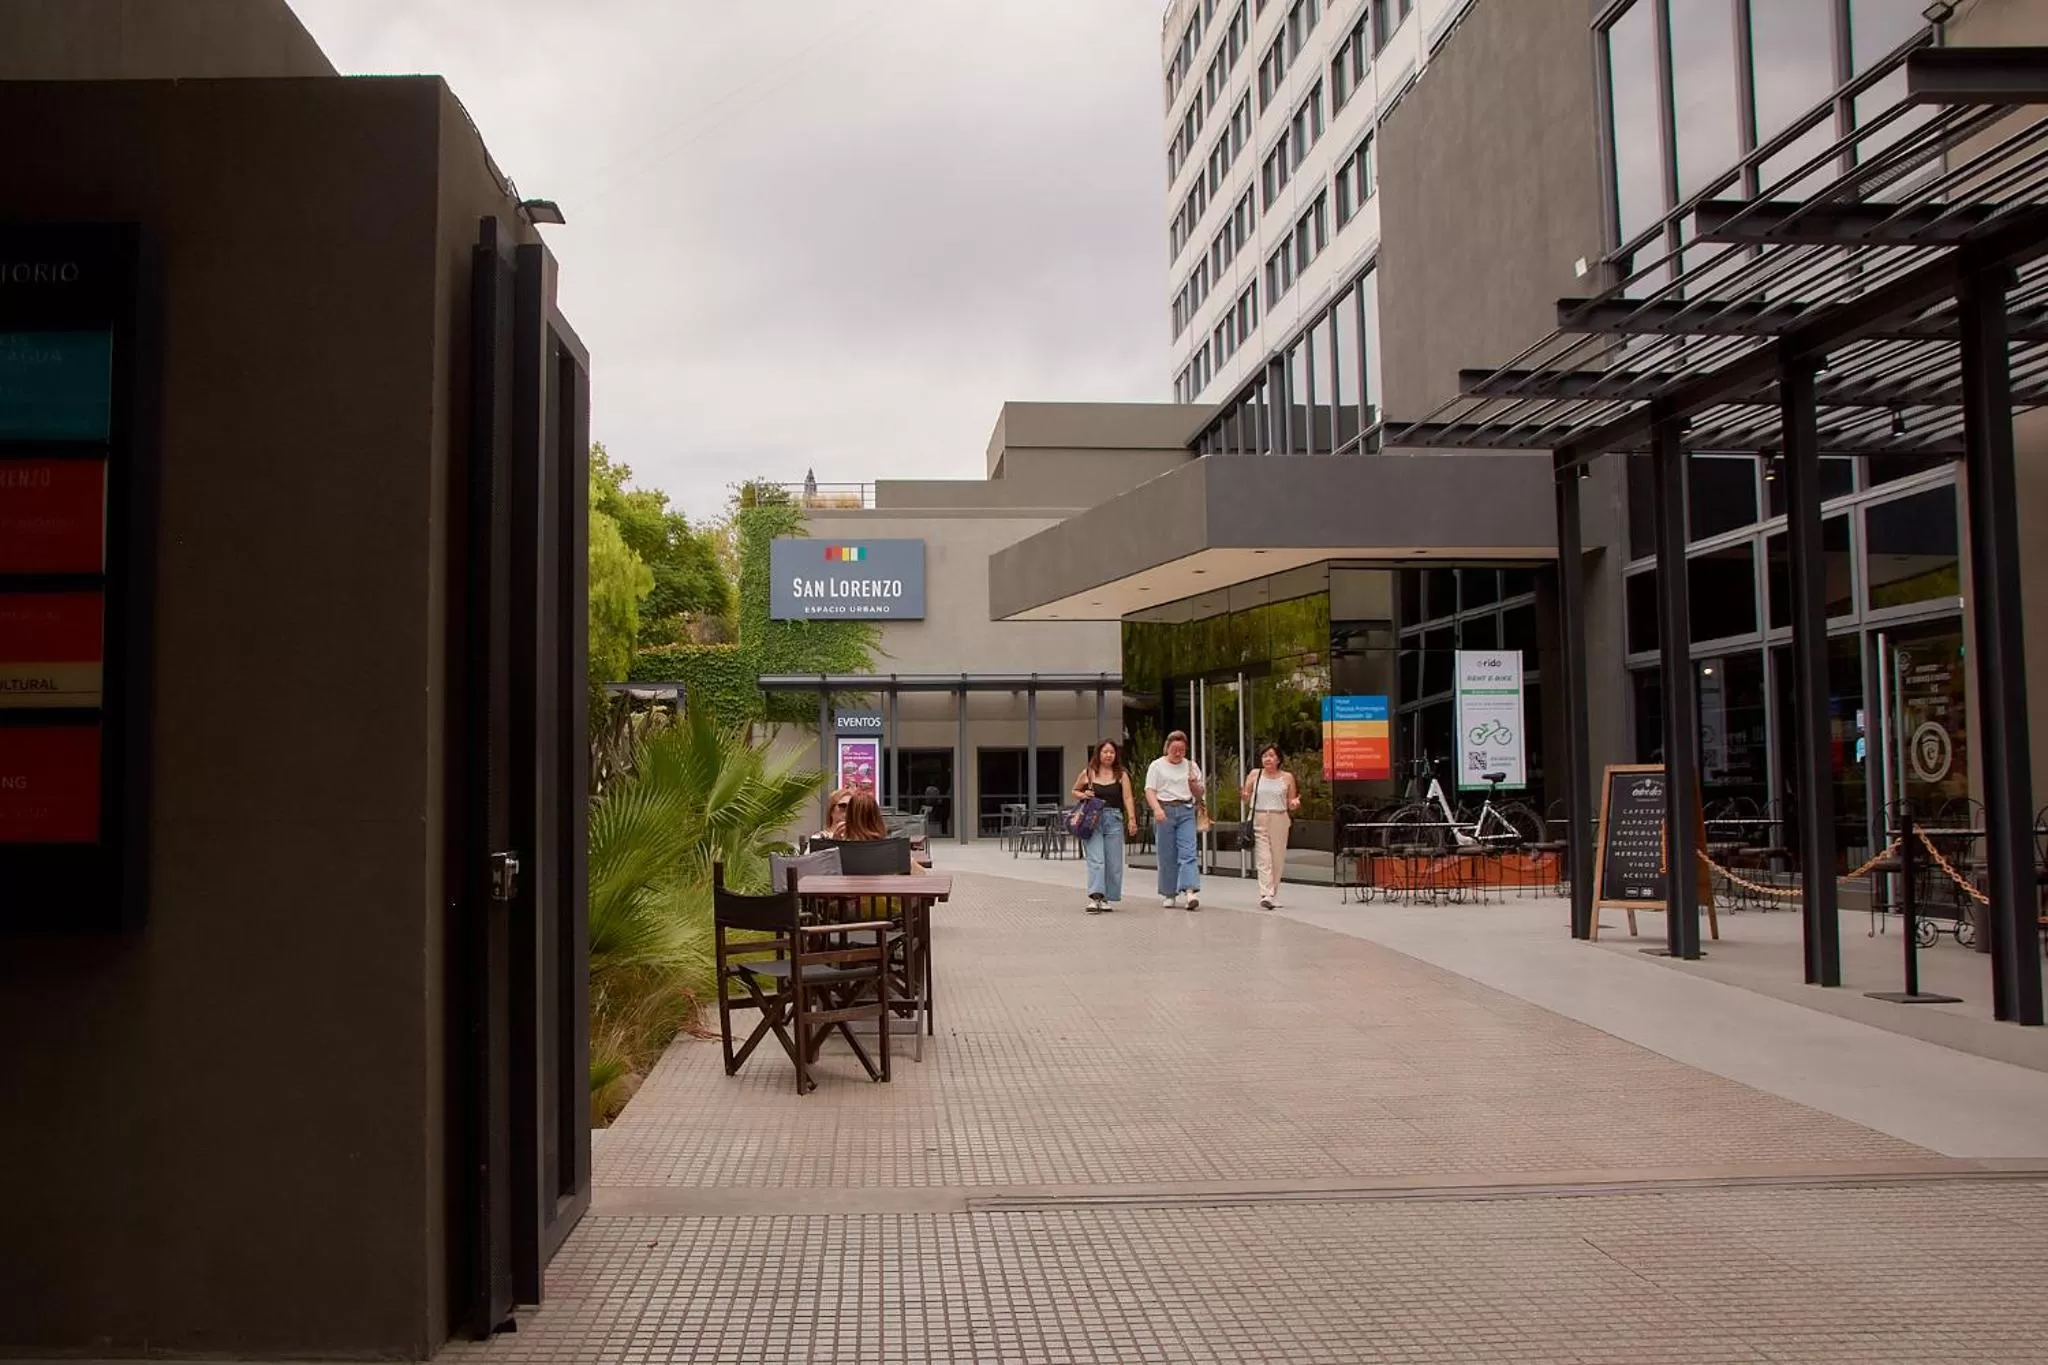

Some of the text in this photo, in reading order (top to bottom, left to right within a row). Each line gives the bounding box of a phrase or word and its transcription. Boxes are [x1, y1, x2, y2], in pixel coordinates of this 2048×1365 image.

[793, 577, 902, 598] SAN LORENZO
[804, 605, 891, 614] ESPACIO URBANO
[837, 717, 882, 727] EVENTOS
